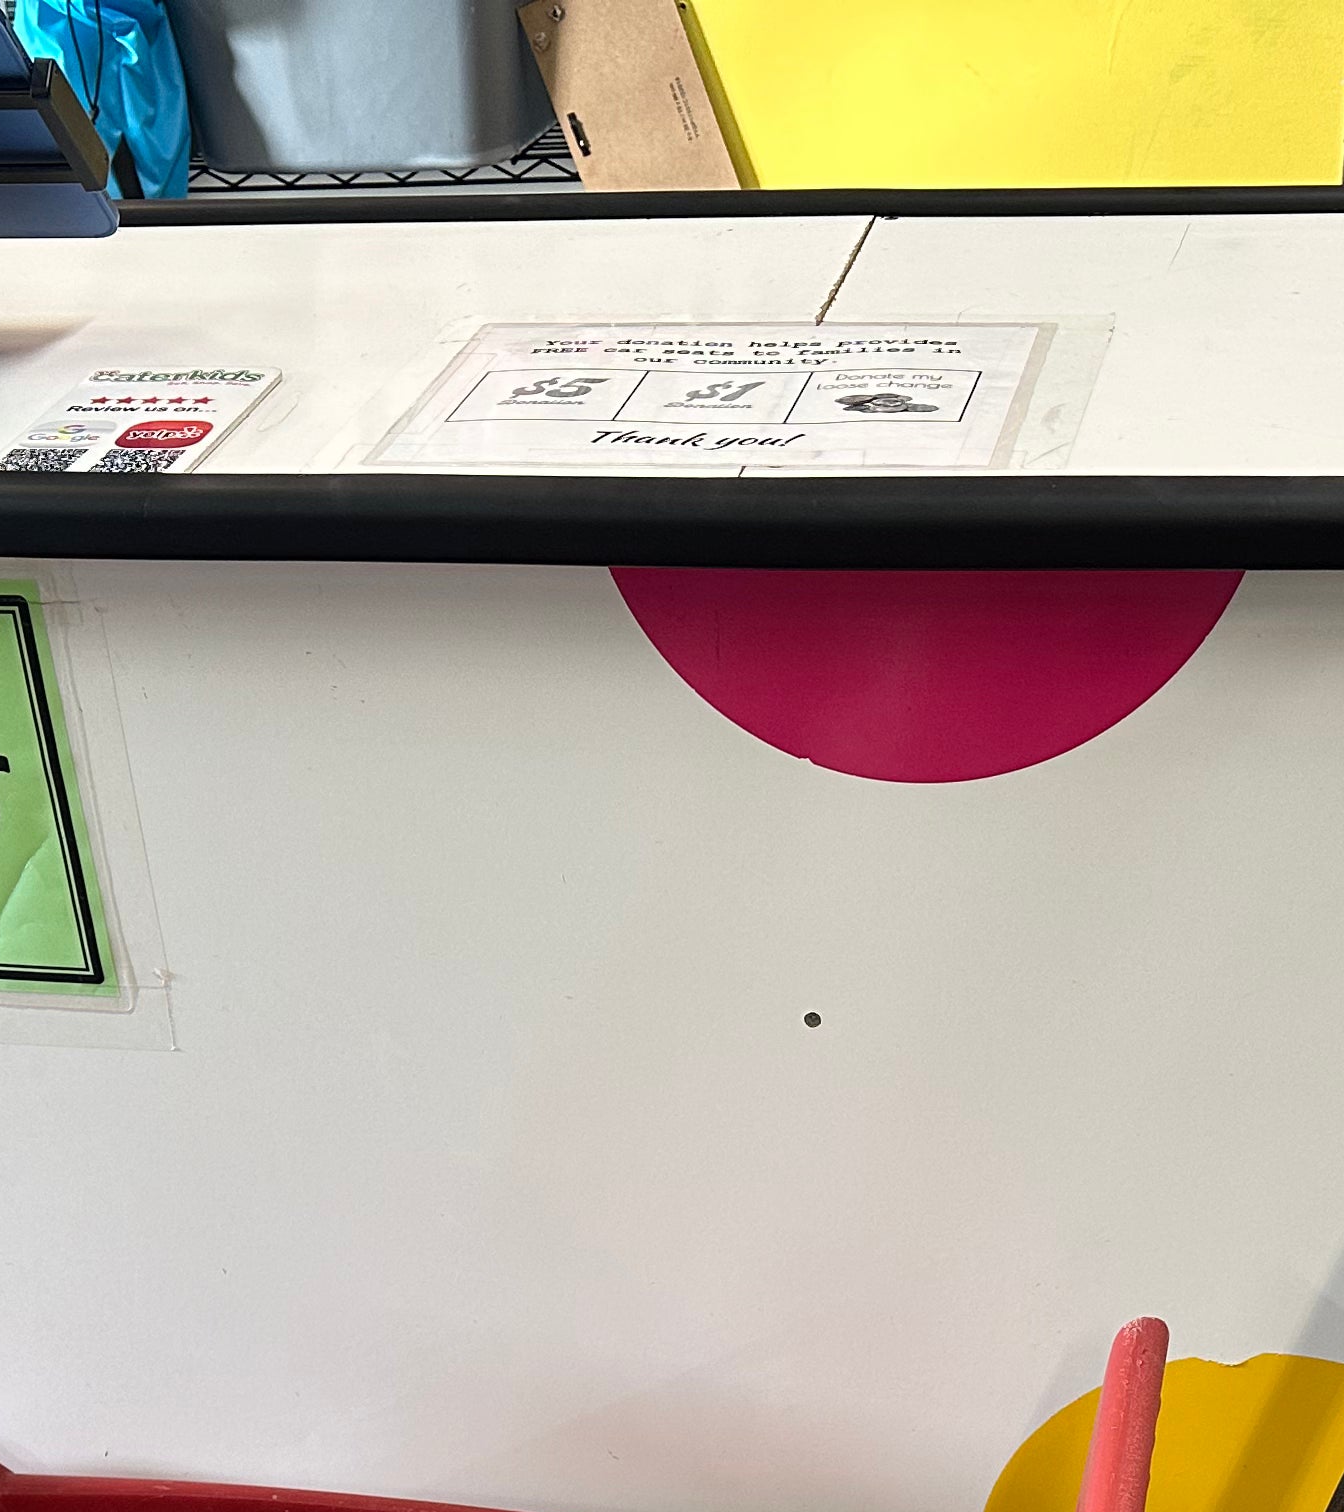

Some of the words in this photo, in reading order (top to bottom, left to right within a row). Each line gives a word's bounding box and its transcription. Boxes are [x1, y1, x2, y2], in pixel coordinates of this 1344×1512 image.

[617, 339, 733, 347] donation
[748, 340, 822, 348] helps
[836, 339, 958, 347] provides
[797, 347, 916, 356] families
[834, 373, 904, 381] Donate
[512, 377, 610, 398] $5
[685, 381, 766, 402] $1
[816, 382, 869, 390] loose
[876, 381, 954, 390] change
[66, 405, 140, 413] Review
[27, 433, 100, 443] Google
[590, 431, 708, 446] Thank
[703, 433, 806, 450] you!
